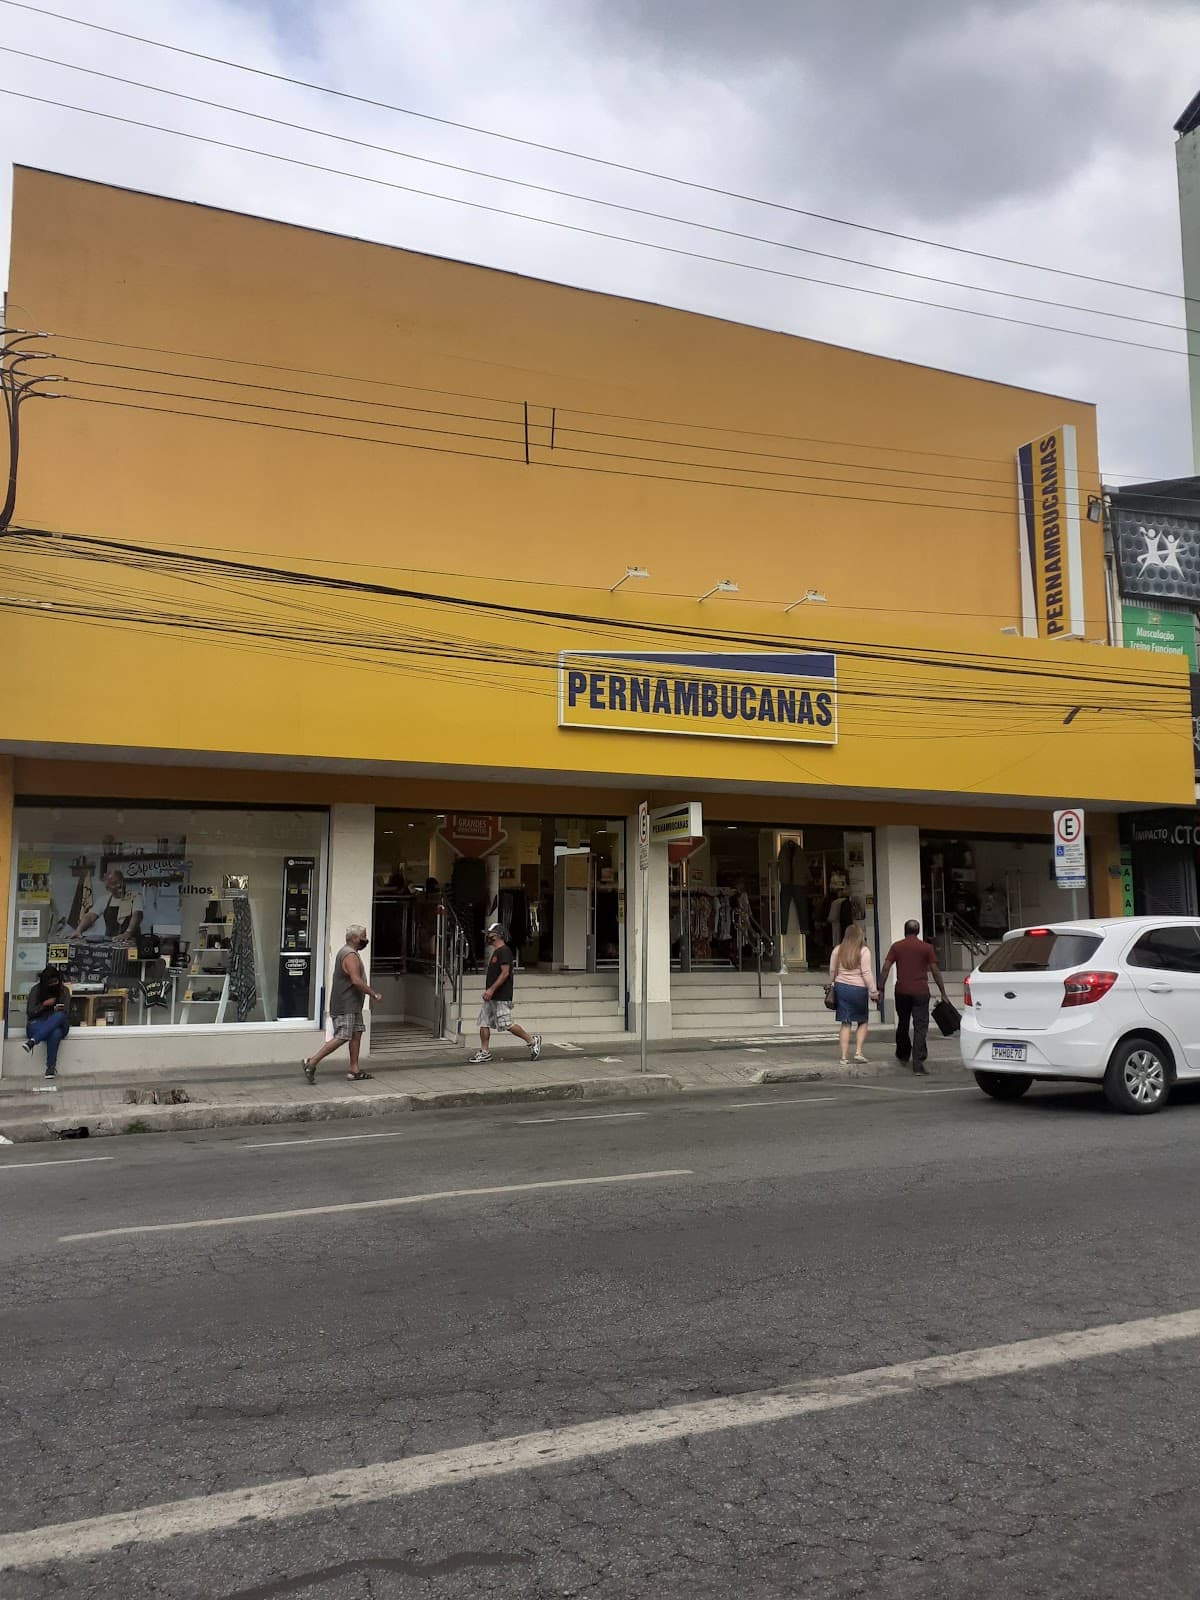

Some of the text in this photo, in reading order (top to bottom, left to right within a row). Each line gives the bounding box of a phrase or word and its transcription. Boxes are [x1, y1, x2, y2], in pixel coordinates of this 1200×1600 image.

[1039, 435, 1064, 636] PERNAMBUCANAS
[1136, 627, 1175, 641] Musculação
[1129, 641, 1184, 656] Treino Funcional
[568, 671, 832, 726] PERNAMBUCANAS
[1065, 818, 1073, 835] E
